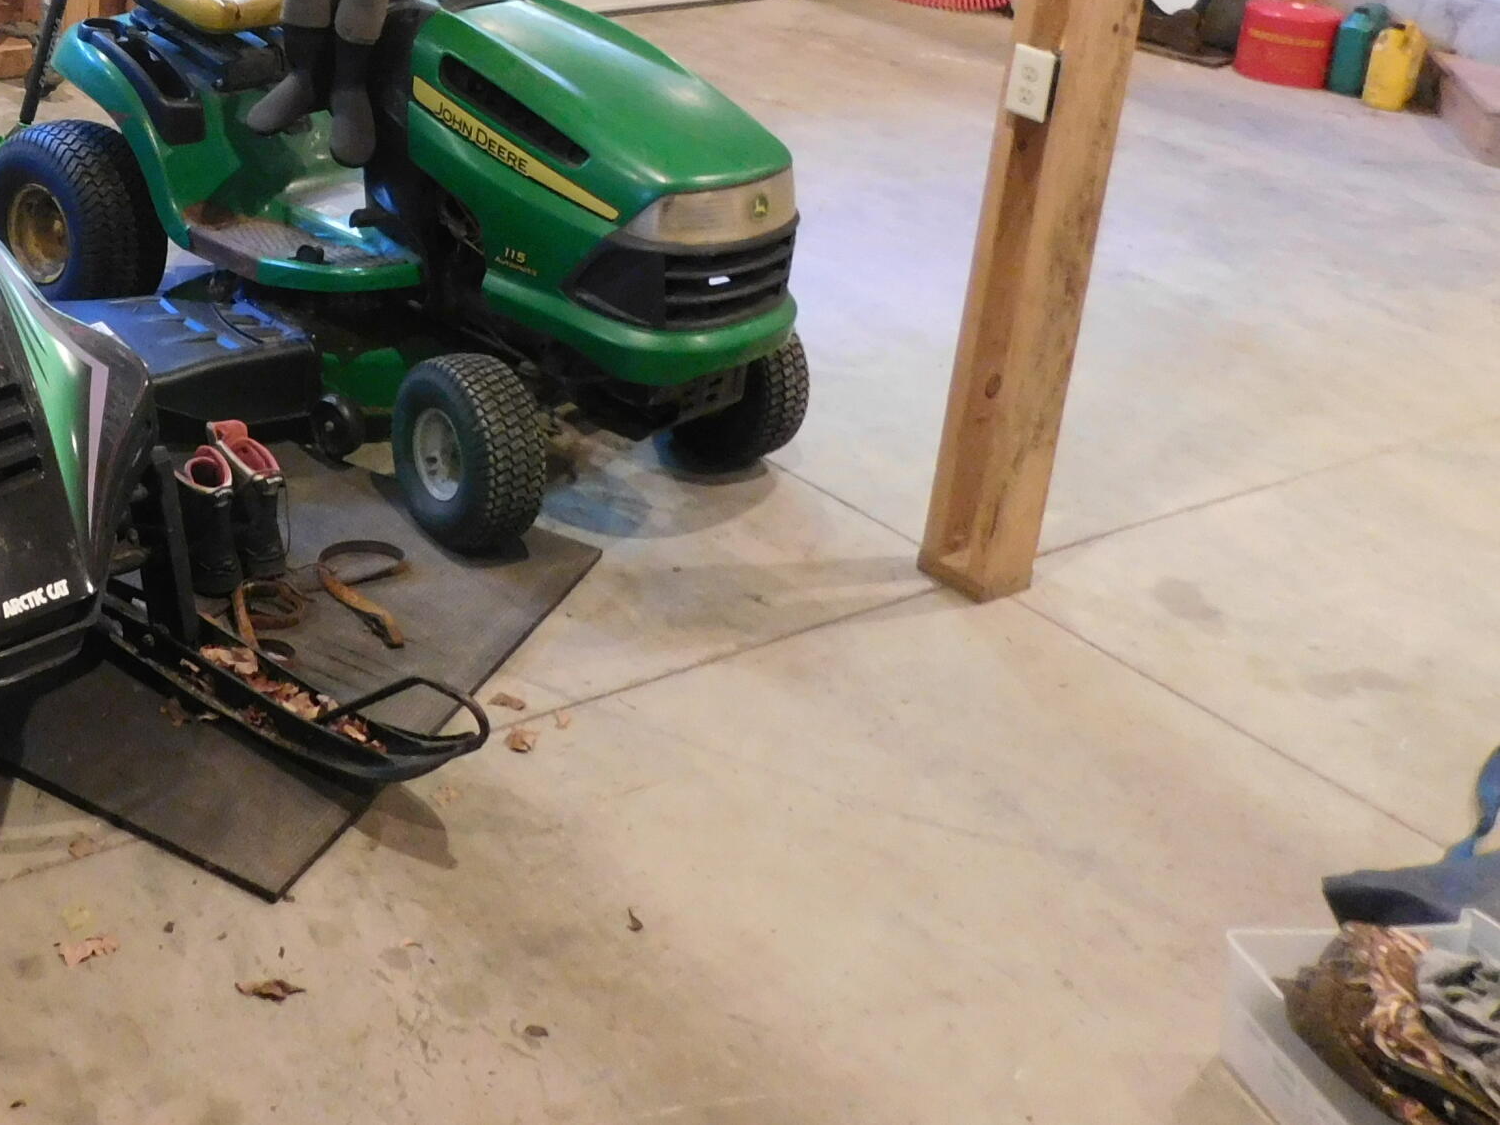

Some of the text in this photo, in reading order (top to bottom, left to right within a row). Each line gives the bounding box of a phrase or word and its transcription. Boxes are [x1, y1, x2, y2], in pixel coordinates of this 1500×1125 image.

[435, 102, 529, 174] JOHN DEERE
[505, 247, 526, 264] 115
[2, 579, 69, 619] ARCTIC CAT
